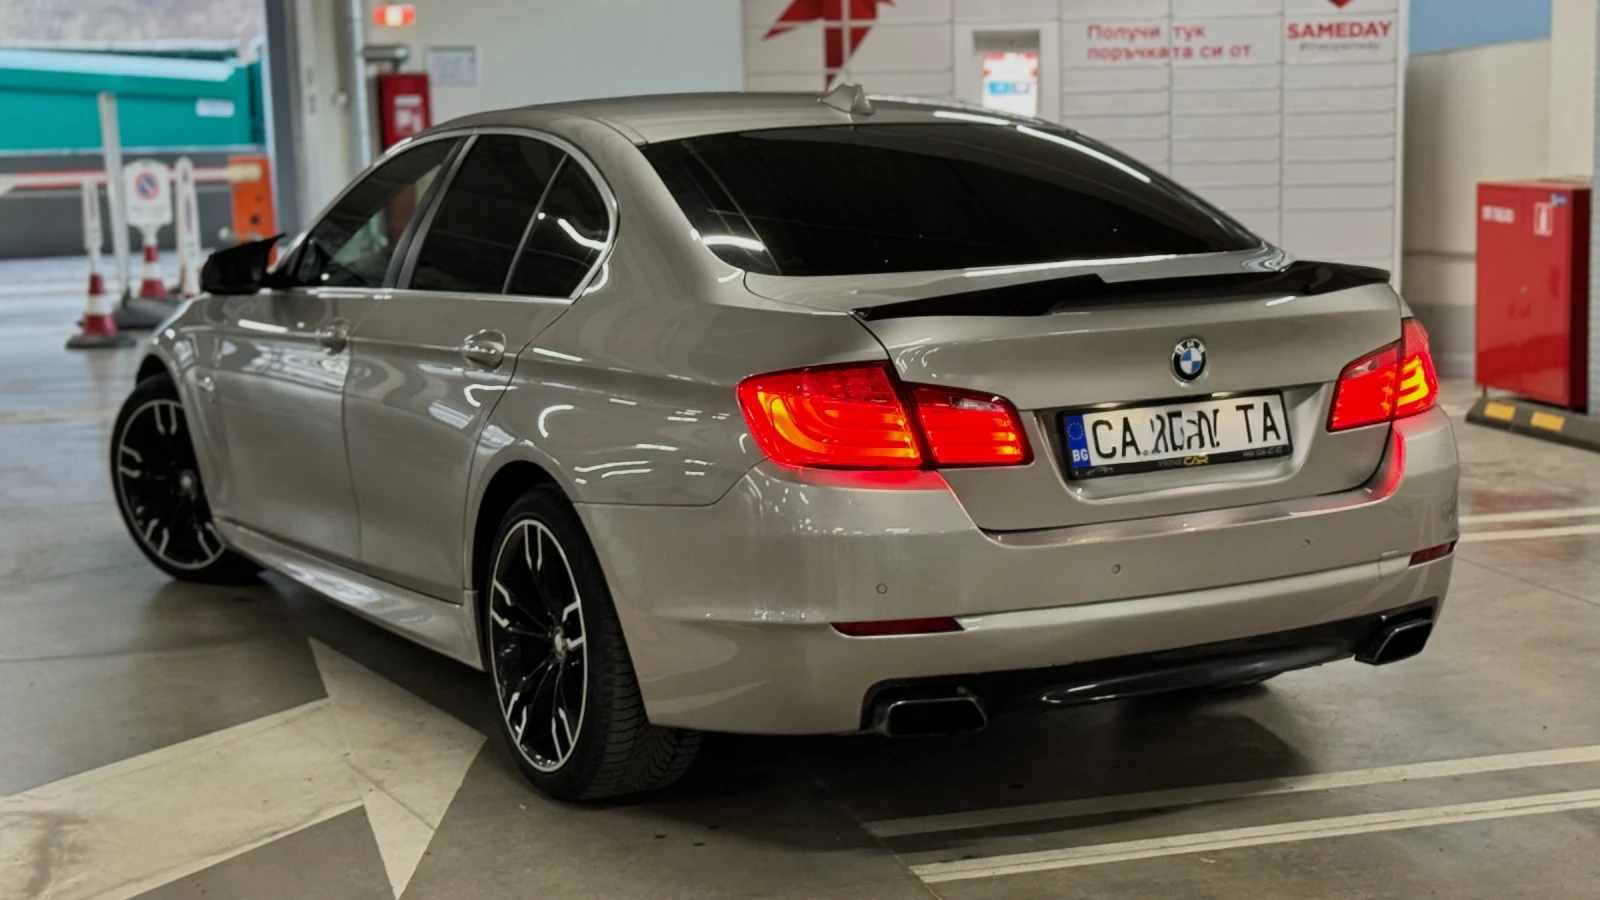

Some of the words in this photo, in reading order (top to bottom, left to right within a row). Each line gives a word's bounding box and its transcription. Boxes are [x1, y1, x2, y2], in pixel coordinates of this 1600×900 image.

[1087, 24, 1160, 42] Получи
[1173, 26, 1206, 41] тук
[1287, 21, 1392, 39] SAMEDAY
[1087, 47, 1192, 62] поръчката
[1200, 46, 1223, 58] си
[1230, 44, 1252, 57] от
[1092, 416, 1141, 459] CA
[1235, 402, 1281, 443] TA
[1072, 448, 1089, 462] BG
[1183, 455, 1209, 466] CAR
